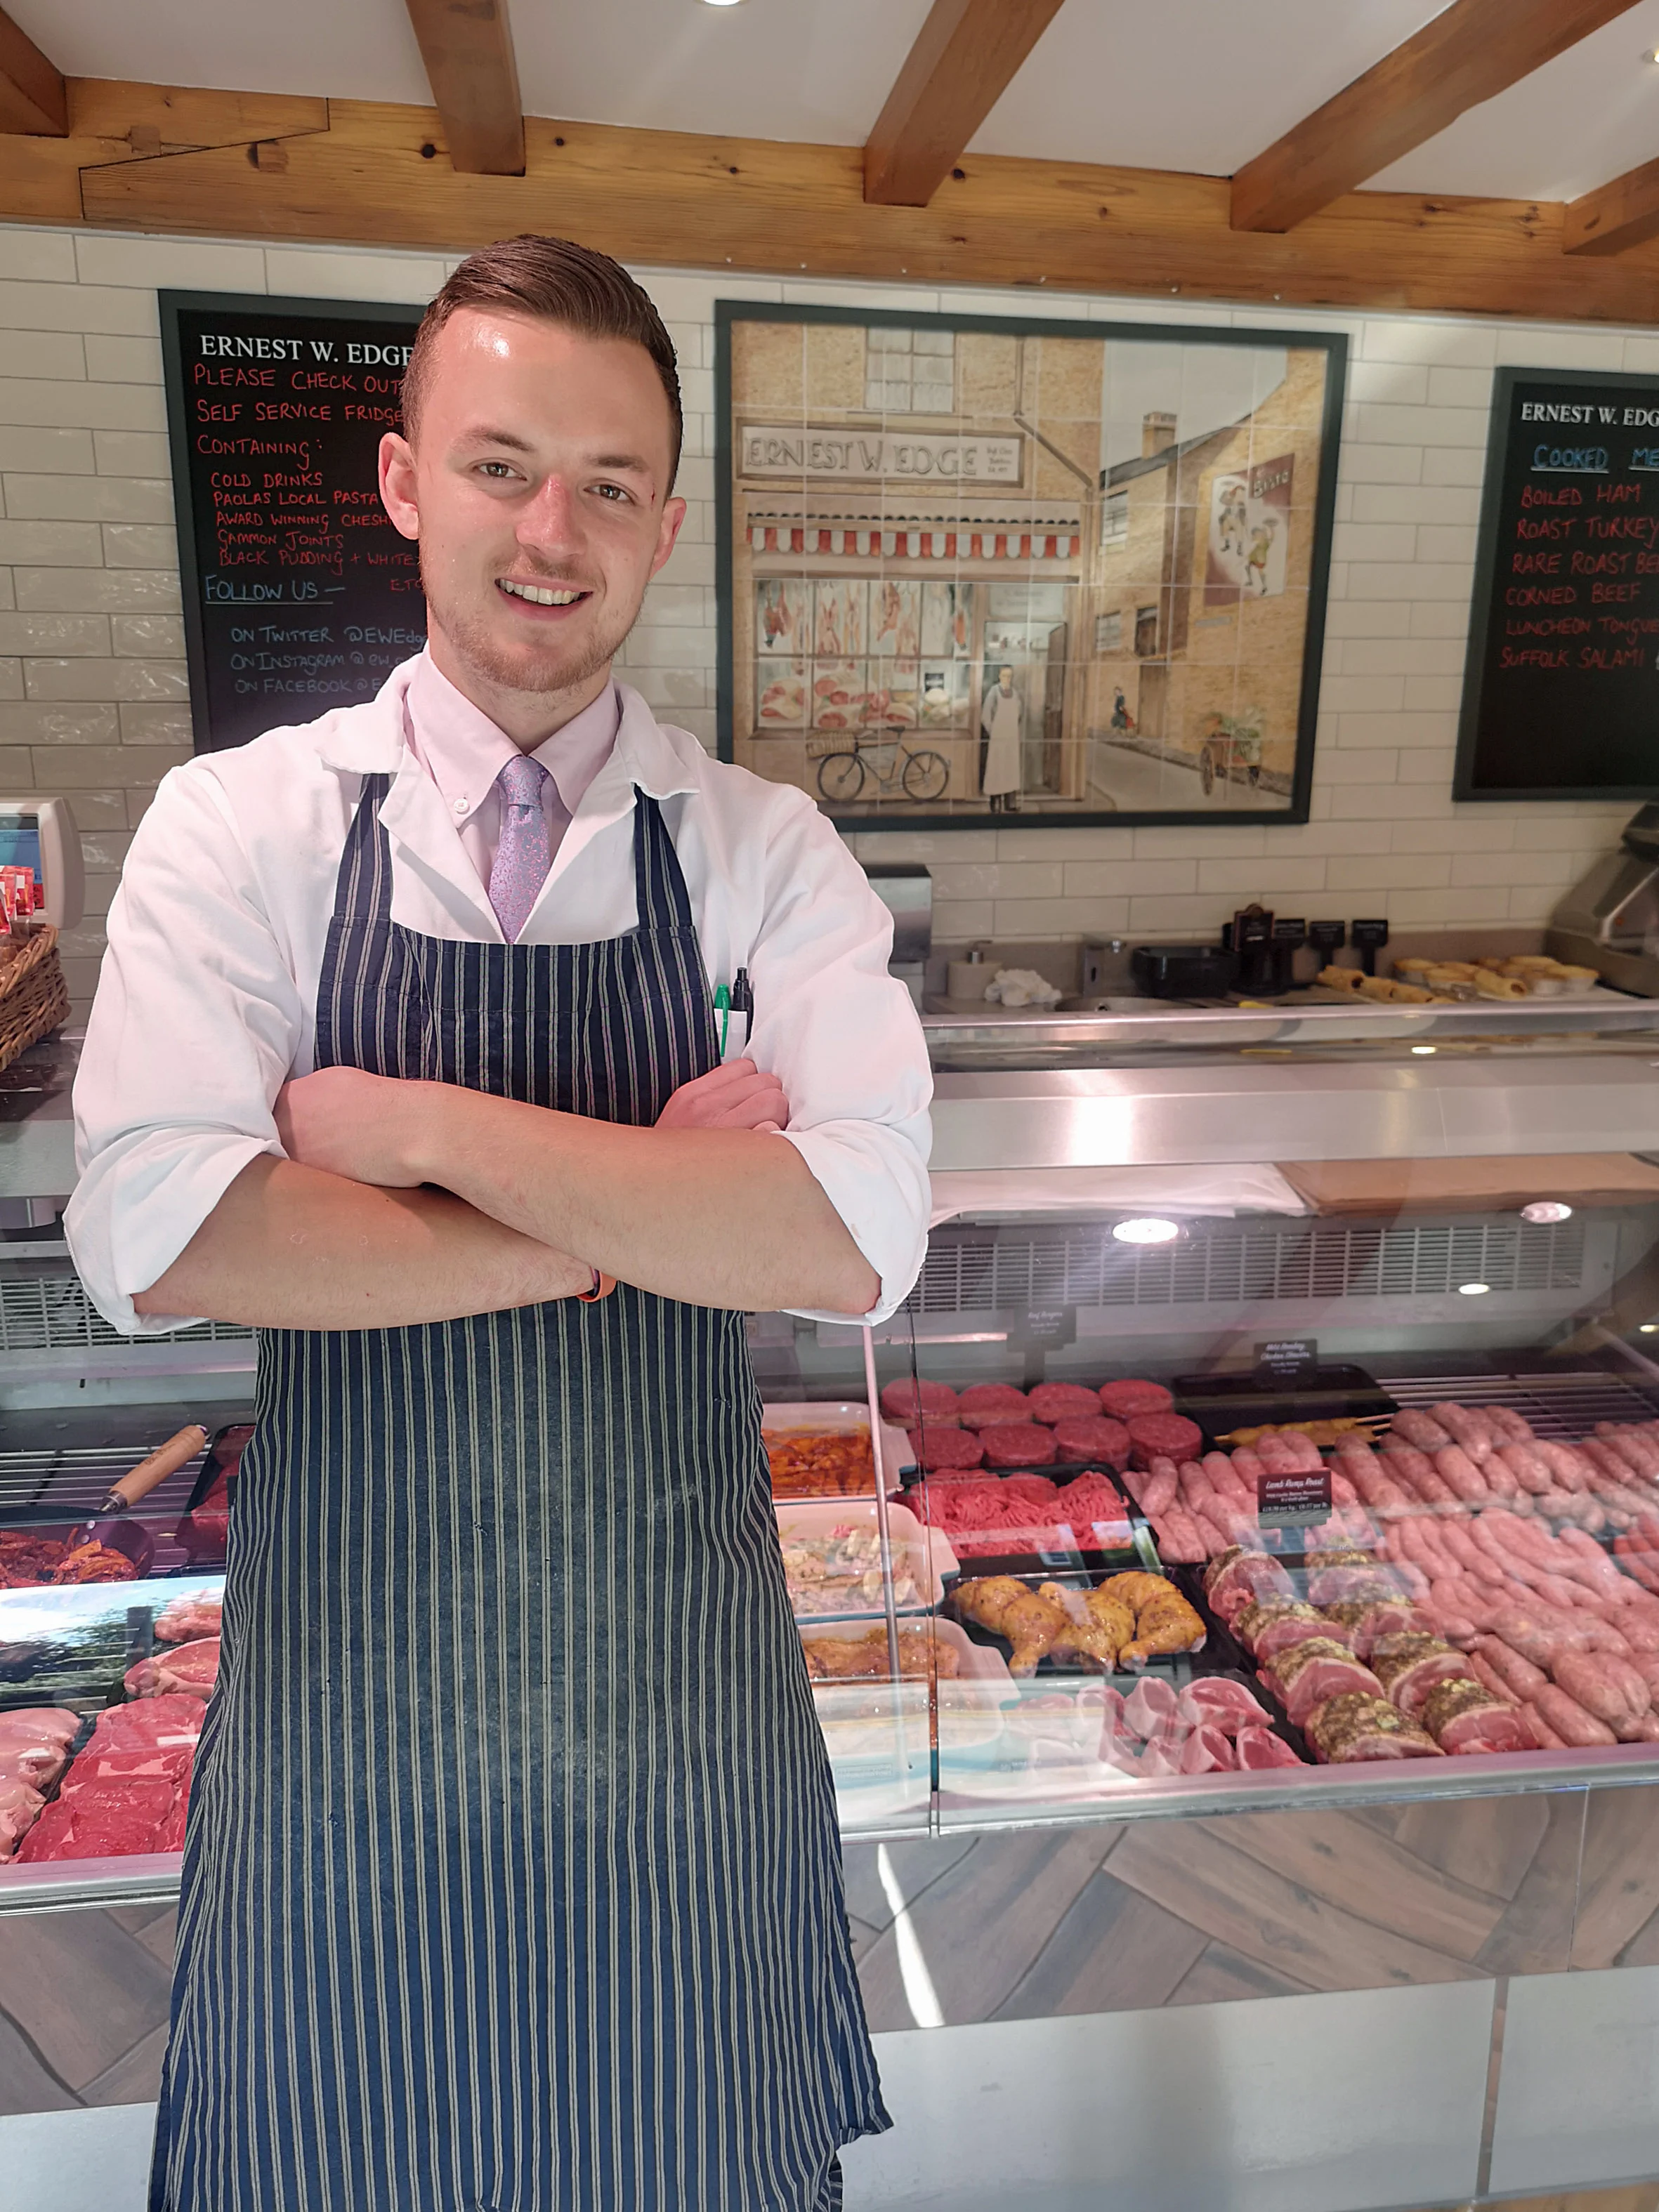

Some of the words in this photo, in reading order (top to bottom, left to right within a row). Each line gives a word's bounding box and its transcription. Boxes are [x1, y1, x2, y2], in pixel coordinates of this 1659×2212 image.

[200, 334, 303, 360] ERNEST
[309, 341, 339, 362] W.
[194, 363, 276, 387] PLEASE
[291, 371, 358, 392] CHECK
[364, 376, 402, 395] OUT
[197, 399, 243, 422] SELF
[255, 402, 332, 421] SERVICE
[1521, 402, 1594, 424] ERNEST
[1597, 406, 1618, 425] W.
[745, 436, 854, 470] ERNEST
[893, 444, 979, 475] EDGE
[1533, 444, 1609, 470] COOKED
[210, 472, 251, 489] COLD
[263, 471, 323, 489] DRINKS
[214, 491, 271, 508] PAOLAS
[278, 491, 327, 506] LOCAL
[333, 490, 379, 506] PASTA
[1521, 485, 1583, 509] BOILED
[1596, 482, 1641, 503] HAM
[216, 511, 264, 527] AWARD
[270, 513, 329, 534] WINNING
[1516, 516, 1578, 540] ROAST
[217, 529, 277, 551] GAMMON
[285, 530, 344, 551] JOINTS
[219, 548, 270, 566] BLACK
[278, 549, 343, 575] PUDDING
[367, 552, 417, 566] WHITE
[1512, 552, 1563, 575] RARE
[1571, 550, 1633, 575] ROAST
[206, 574, 282, 601] FOLLOW
[1505, 586, 1578, 607] CORNED
[1591, 581, 1641, 605] BEEF
[231, 627, 255, 644] ON
[258, 626, 334, 643] TWITTER
[1505, 617, 1591, 636] LUNCHEON
[230, 653, 255, 671] ON
[258, 652, 346, 676] INSTAGRAM
[1500, 646, 1570, 669] SUFFOLK
[1578, 645, 1645, 669] SALAMI
[235, 678, 258, 694] ON
[263, 678, 353, 694] FACEBOOK
